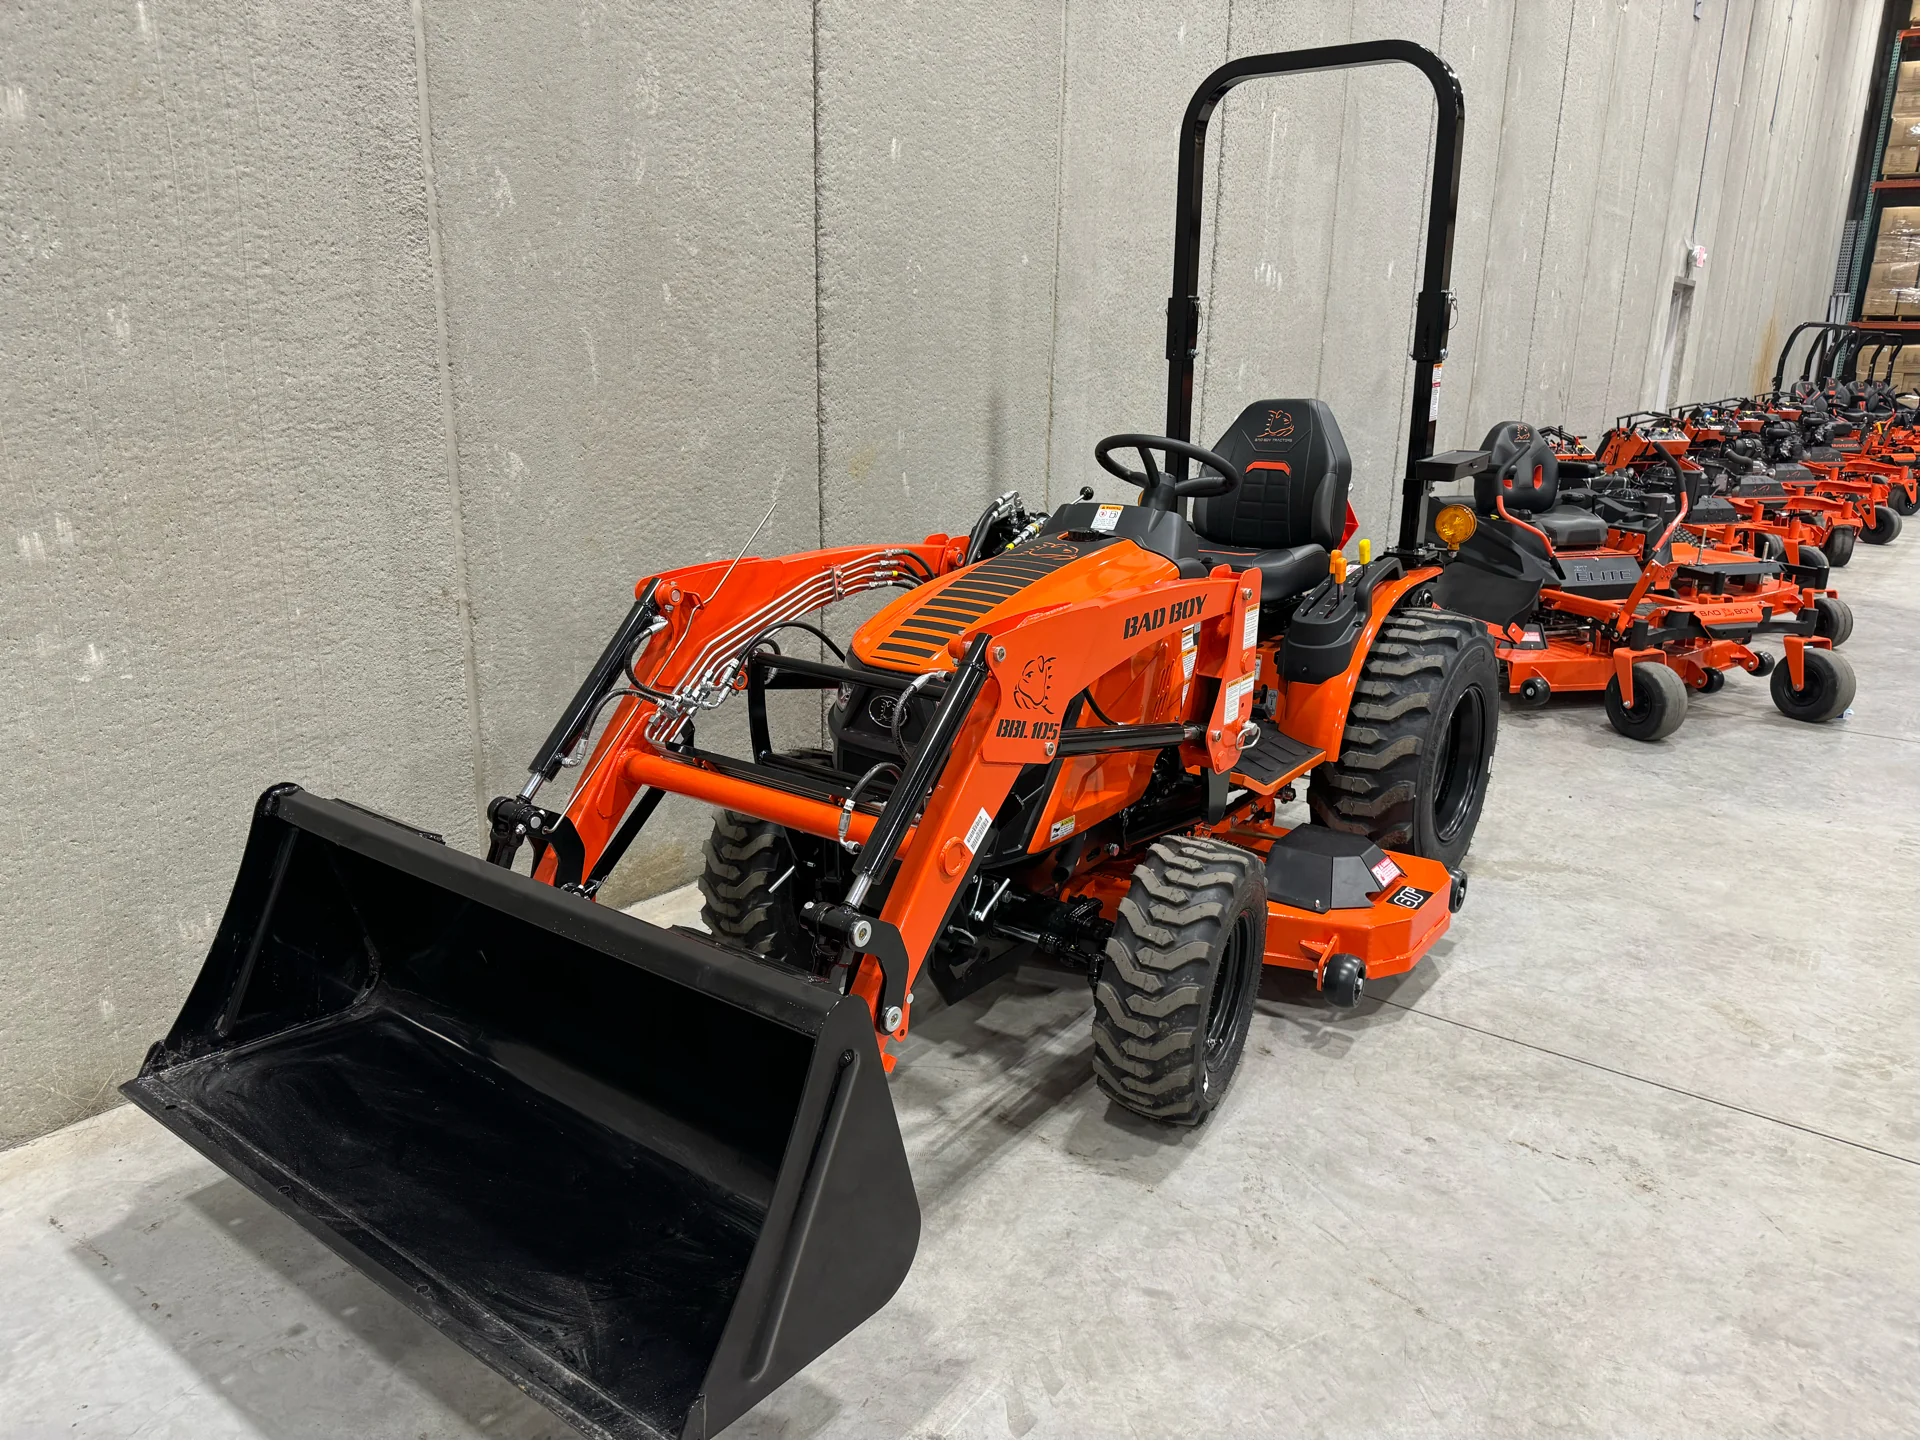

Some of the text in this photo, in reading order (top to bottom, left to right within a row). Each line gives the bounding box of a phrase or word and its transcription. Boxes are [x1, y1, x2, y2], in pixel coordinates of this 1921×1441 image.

[1575, 569, 1633, 583] ELITE
[1123, 607, 1166, 640] BAD
[1168, 593, 1208, 625] BOY
[1699, 607, 1754, 617] BAD BOY
[995, 718, 1060, 741] BBL 105
